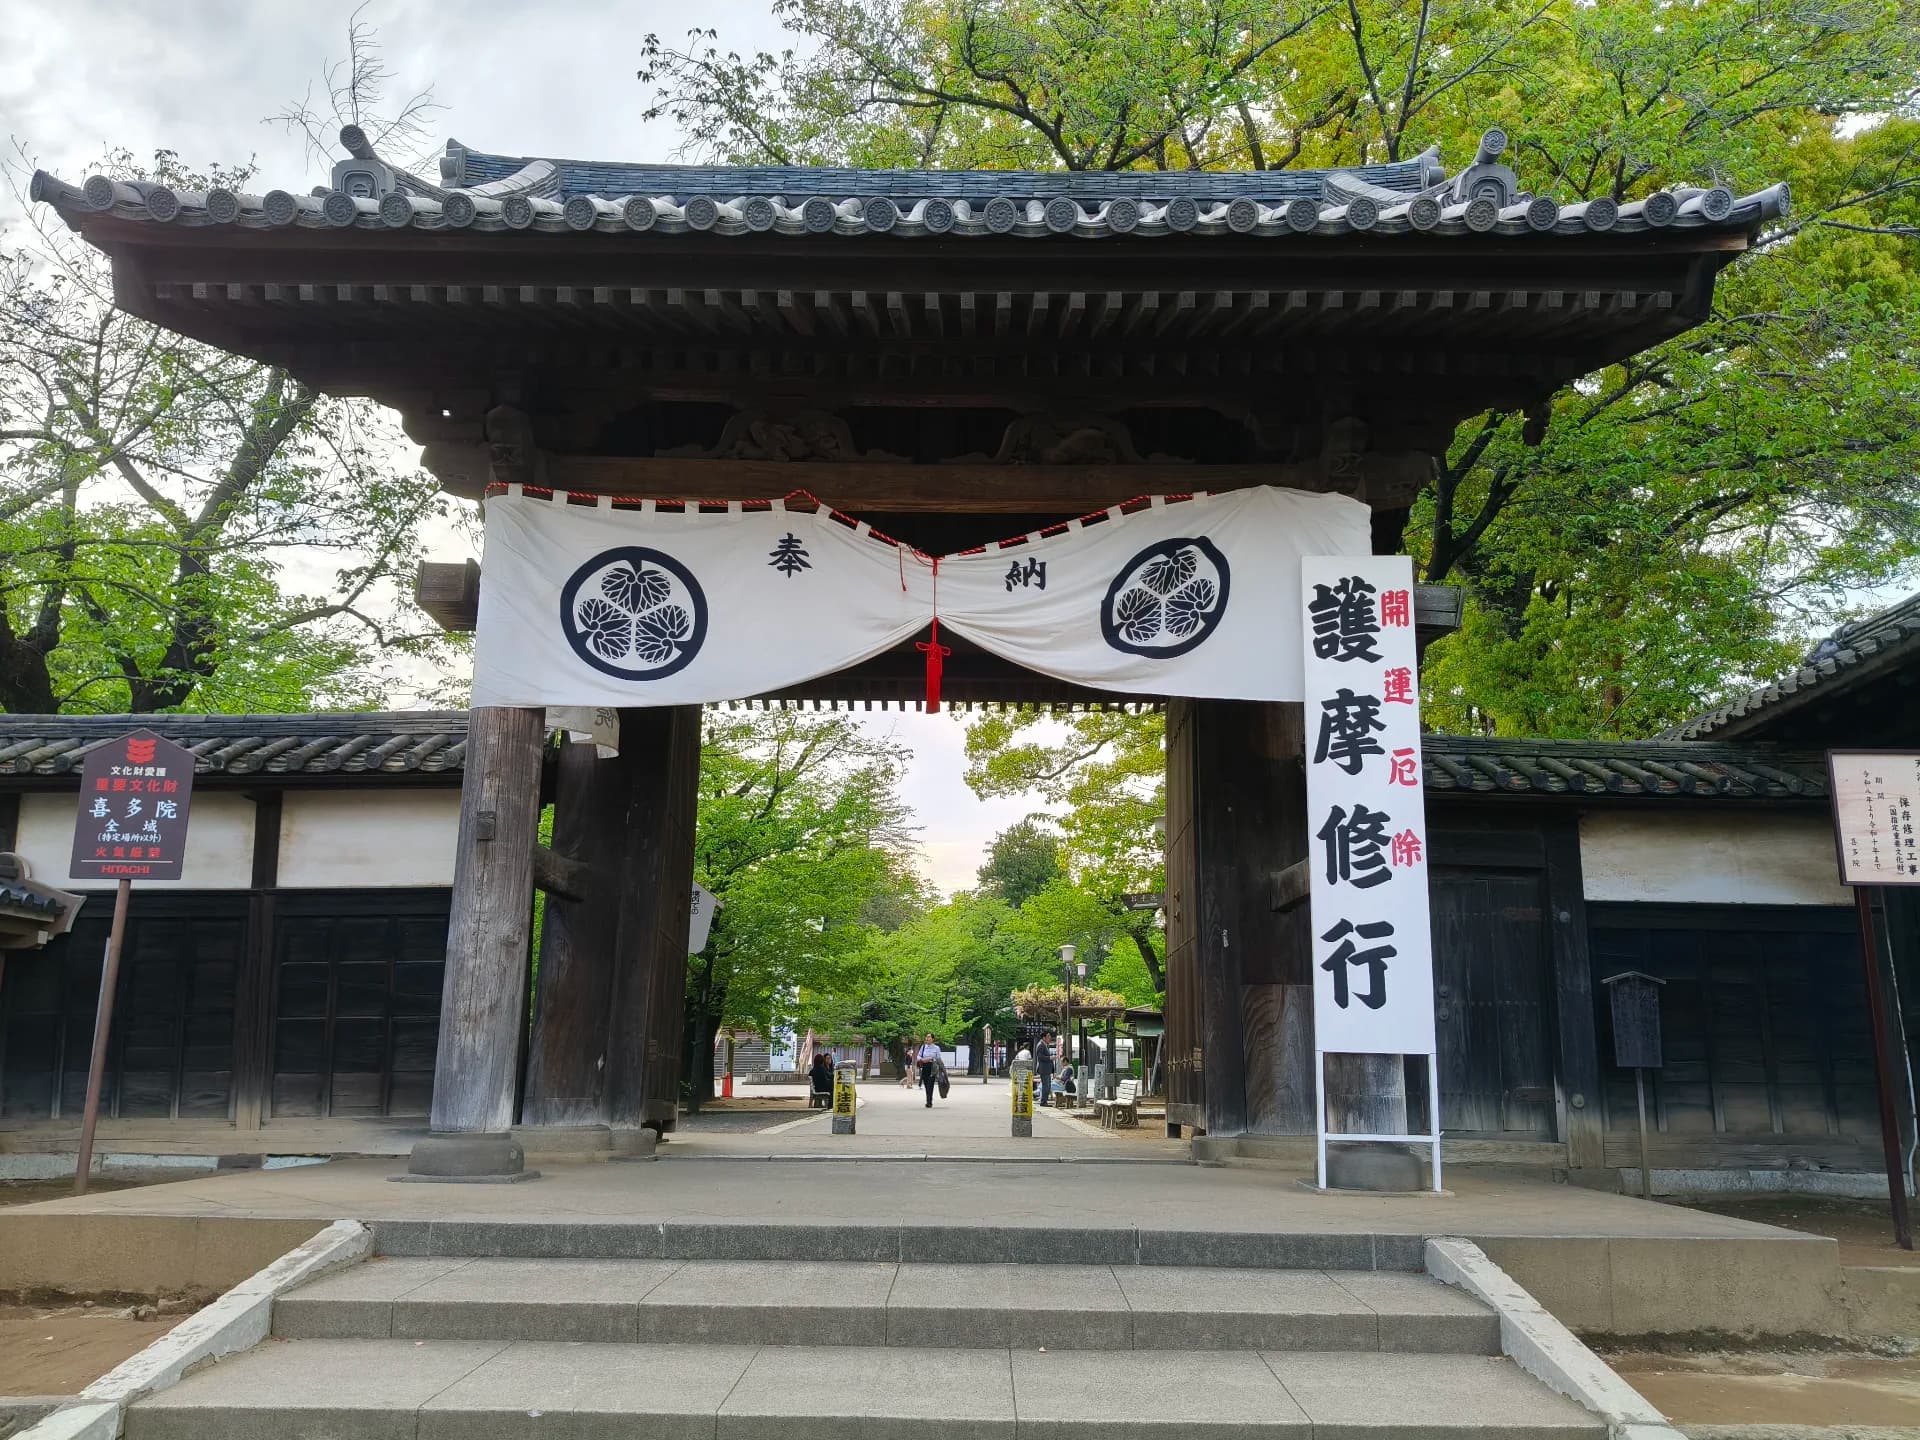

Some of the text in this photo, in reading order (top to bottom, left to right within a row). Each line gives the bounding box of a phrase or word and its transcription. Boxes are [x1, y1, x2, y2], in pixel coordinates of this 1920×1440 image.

[768, 532, 1047, 593] 奉 納
[1380, 589, 1422, 868] 開運厄除
[96, 777, 178, 793] 重要文化財
[1308, 575, 1398, 1011] 護摩修行
[88, 797, 178, 819] 喜多院
[105, 818, 158, 833] 全域
[1900, 797, 1918, 876] 保存修理工事
[101, 864, 150, 874] HITACHI
